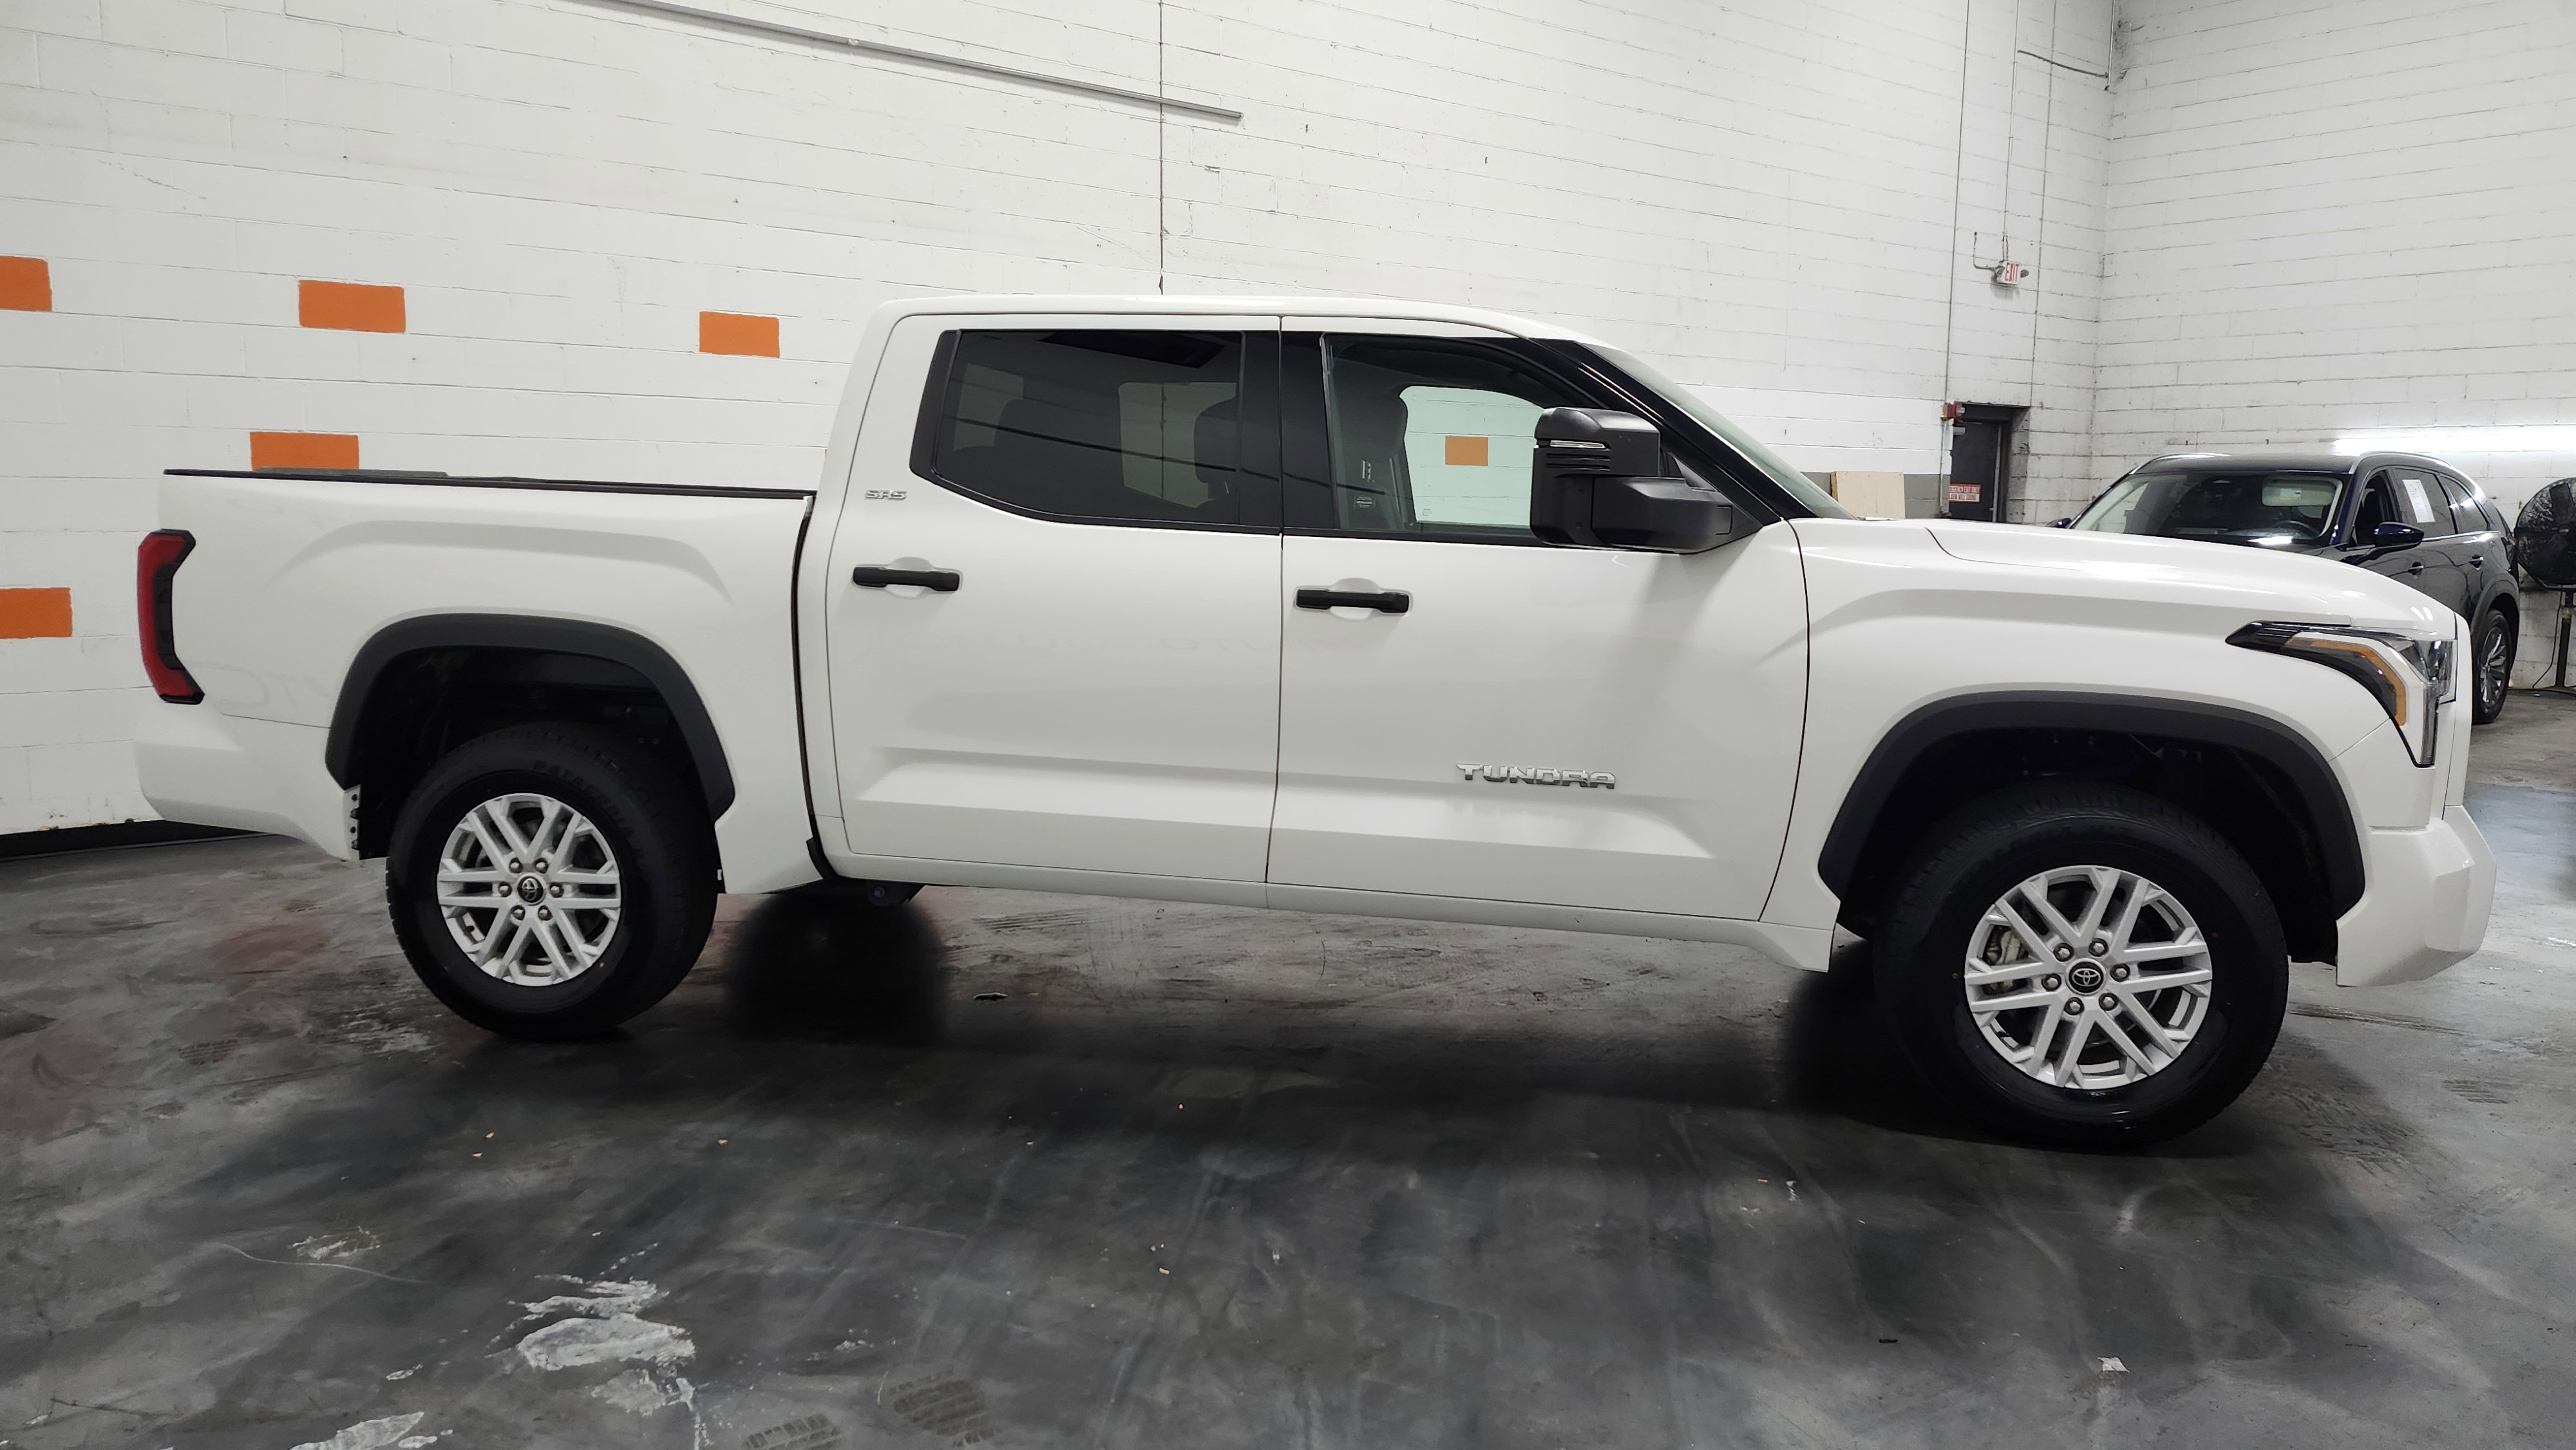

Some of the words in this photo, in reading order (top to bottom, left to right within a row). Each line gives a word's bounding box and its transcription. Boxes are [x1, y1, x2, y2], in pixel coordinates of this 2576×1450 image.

[2005, 262, 2019, 282] EXIT
[864, 489, 907, 500] SR5
[1456, 763, 1615, 789] TUNDRA
